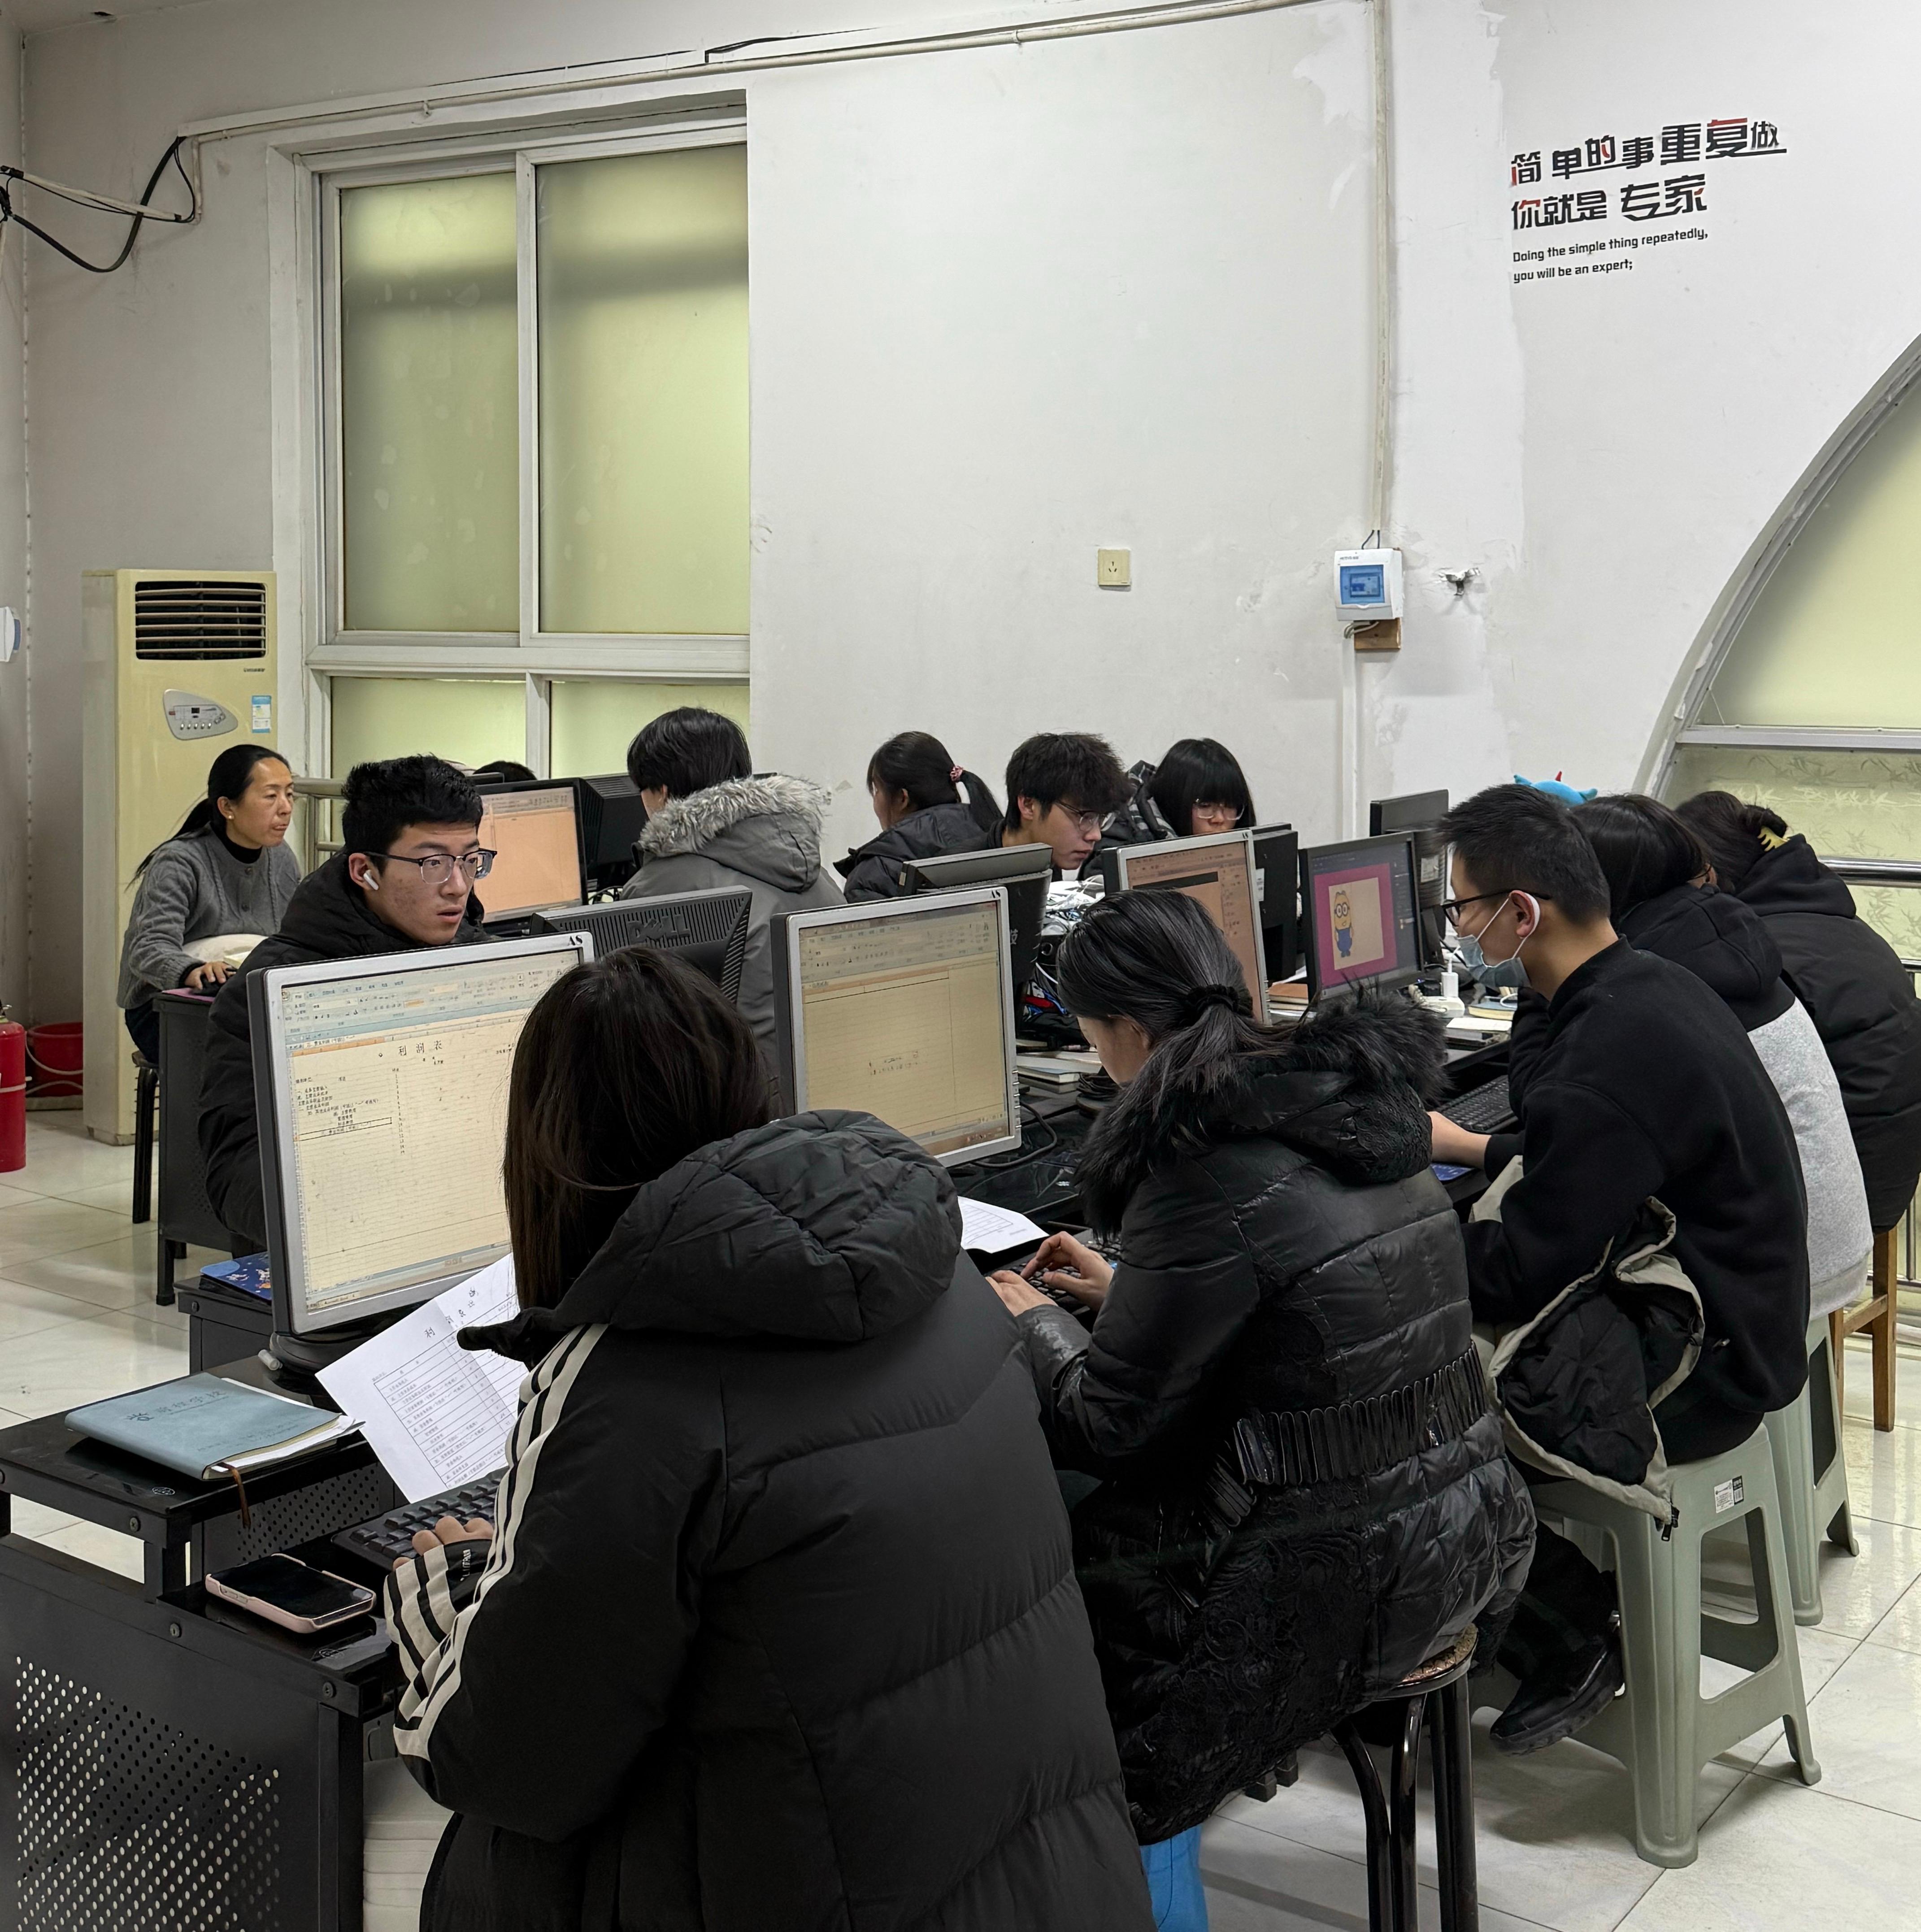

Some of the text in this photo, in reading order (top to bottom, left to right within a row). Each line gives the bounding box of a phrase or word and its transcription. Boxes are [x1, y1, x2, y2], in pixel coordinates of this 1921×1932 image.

[1511, 117, 1787, 186] 简单的事重复做
[1513, 227, 1708, 262] Doing the simple thing repeatedly,
[1513, 259, 1633, 284] you will be an expert;
